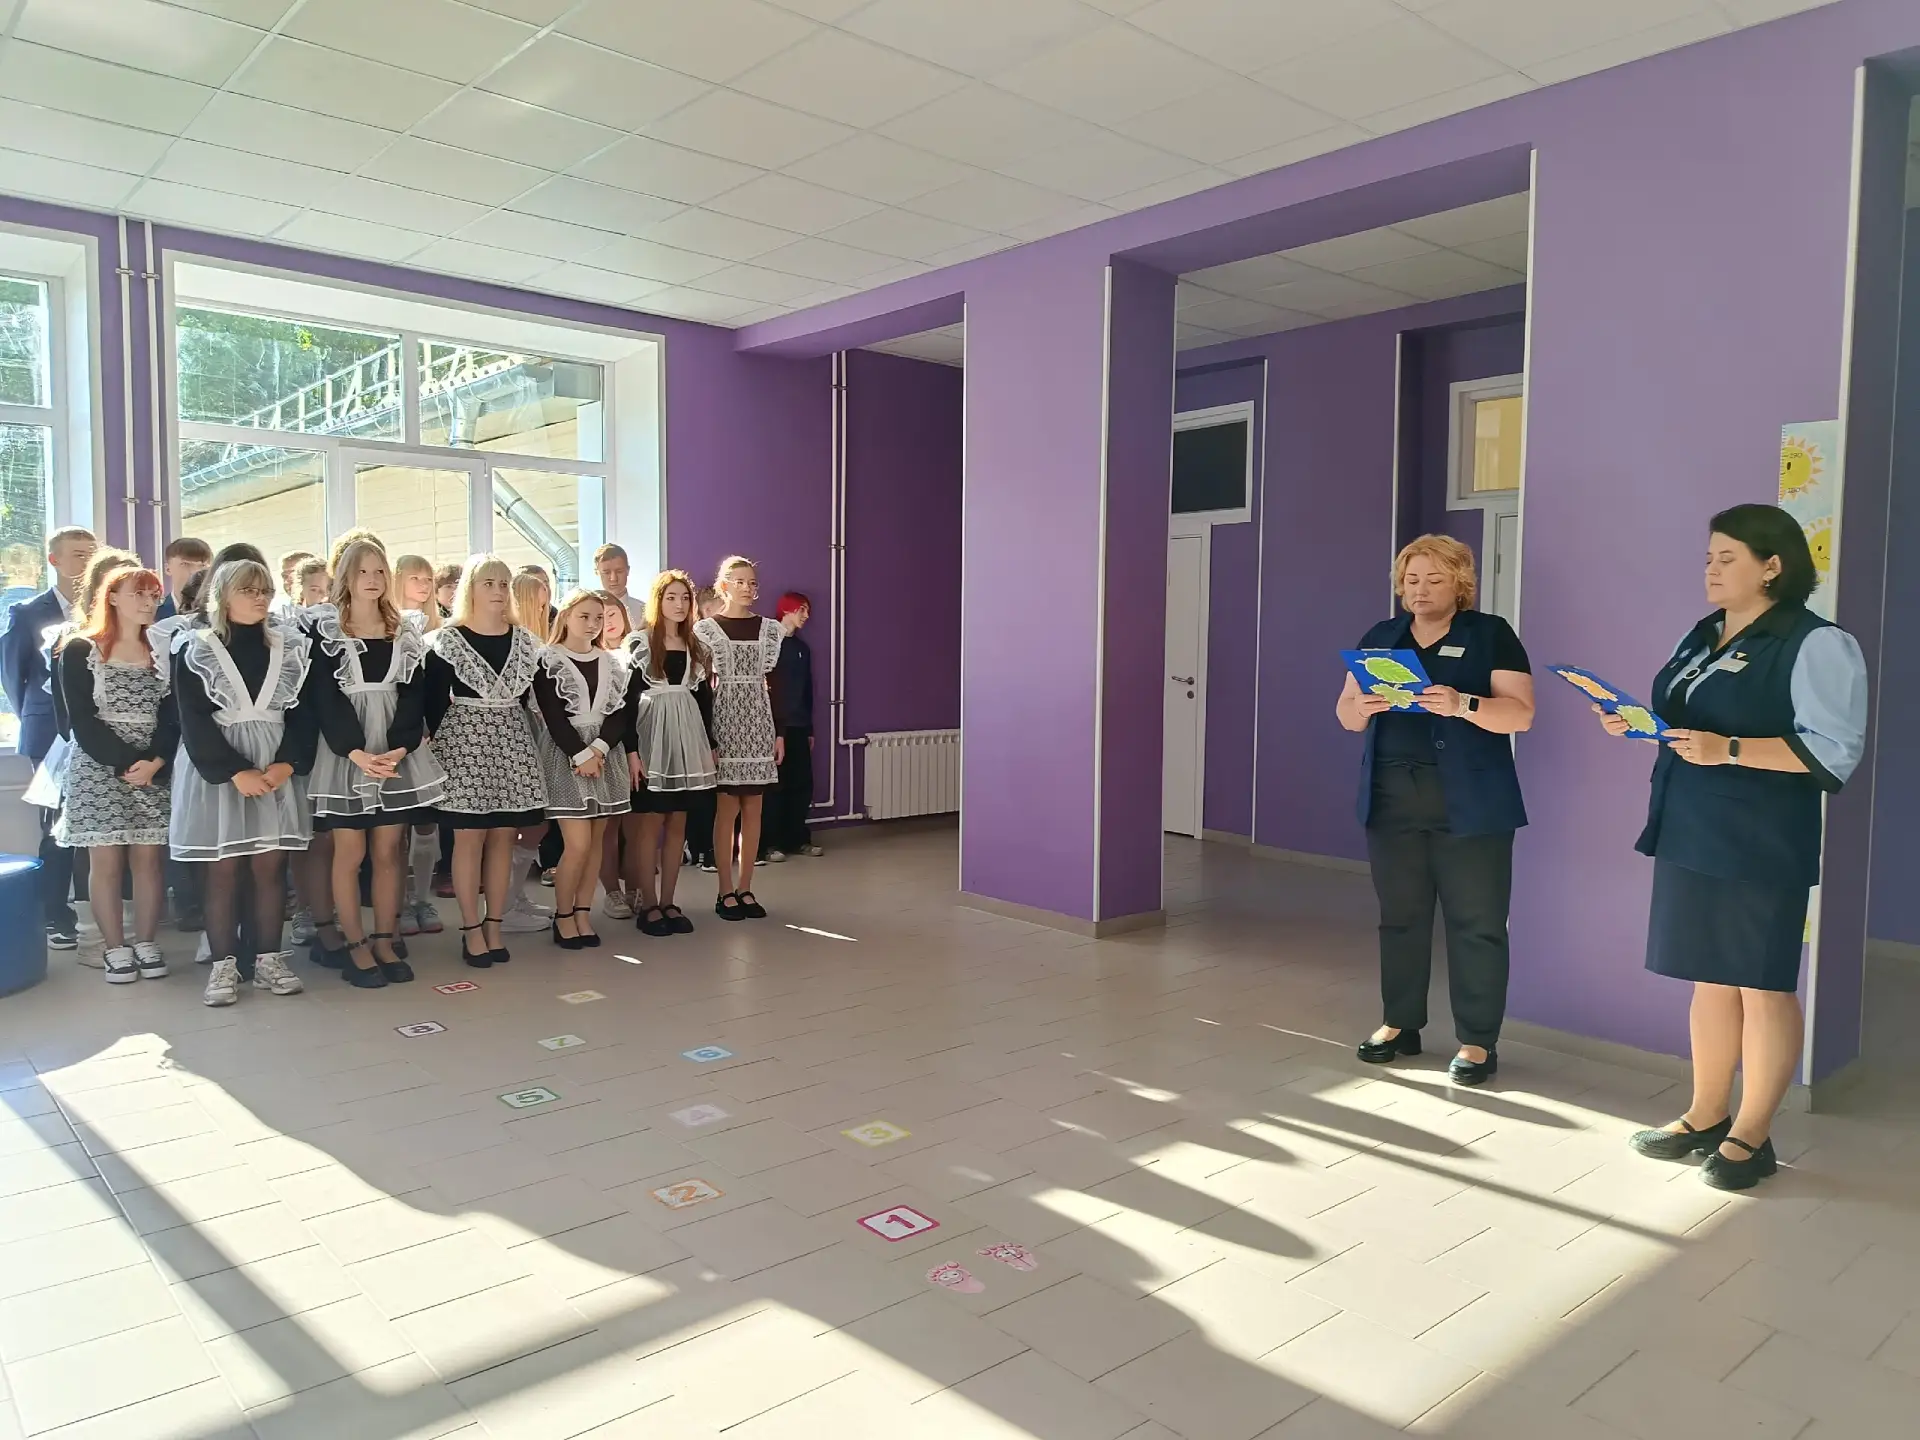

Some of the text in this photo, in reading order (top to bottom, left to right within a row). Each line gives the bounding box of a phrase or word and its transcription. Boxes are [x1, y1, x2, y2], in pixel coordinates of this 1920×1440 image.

[443, 983, 472, 992] 10
[694, 1049, 722, 1058] 6
[516, 1091, 544, 1103] 5
[863, 1127, 892, 1140] 3
[667, 1185, 708, 1202] 2
[885, 1214, 916, 1228] 1
